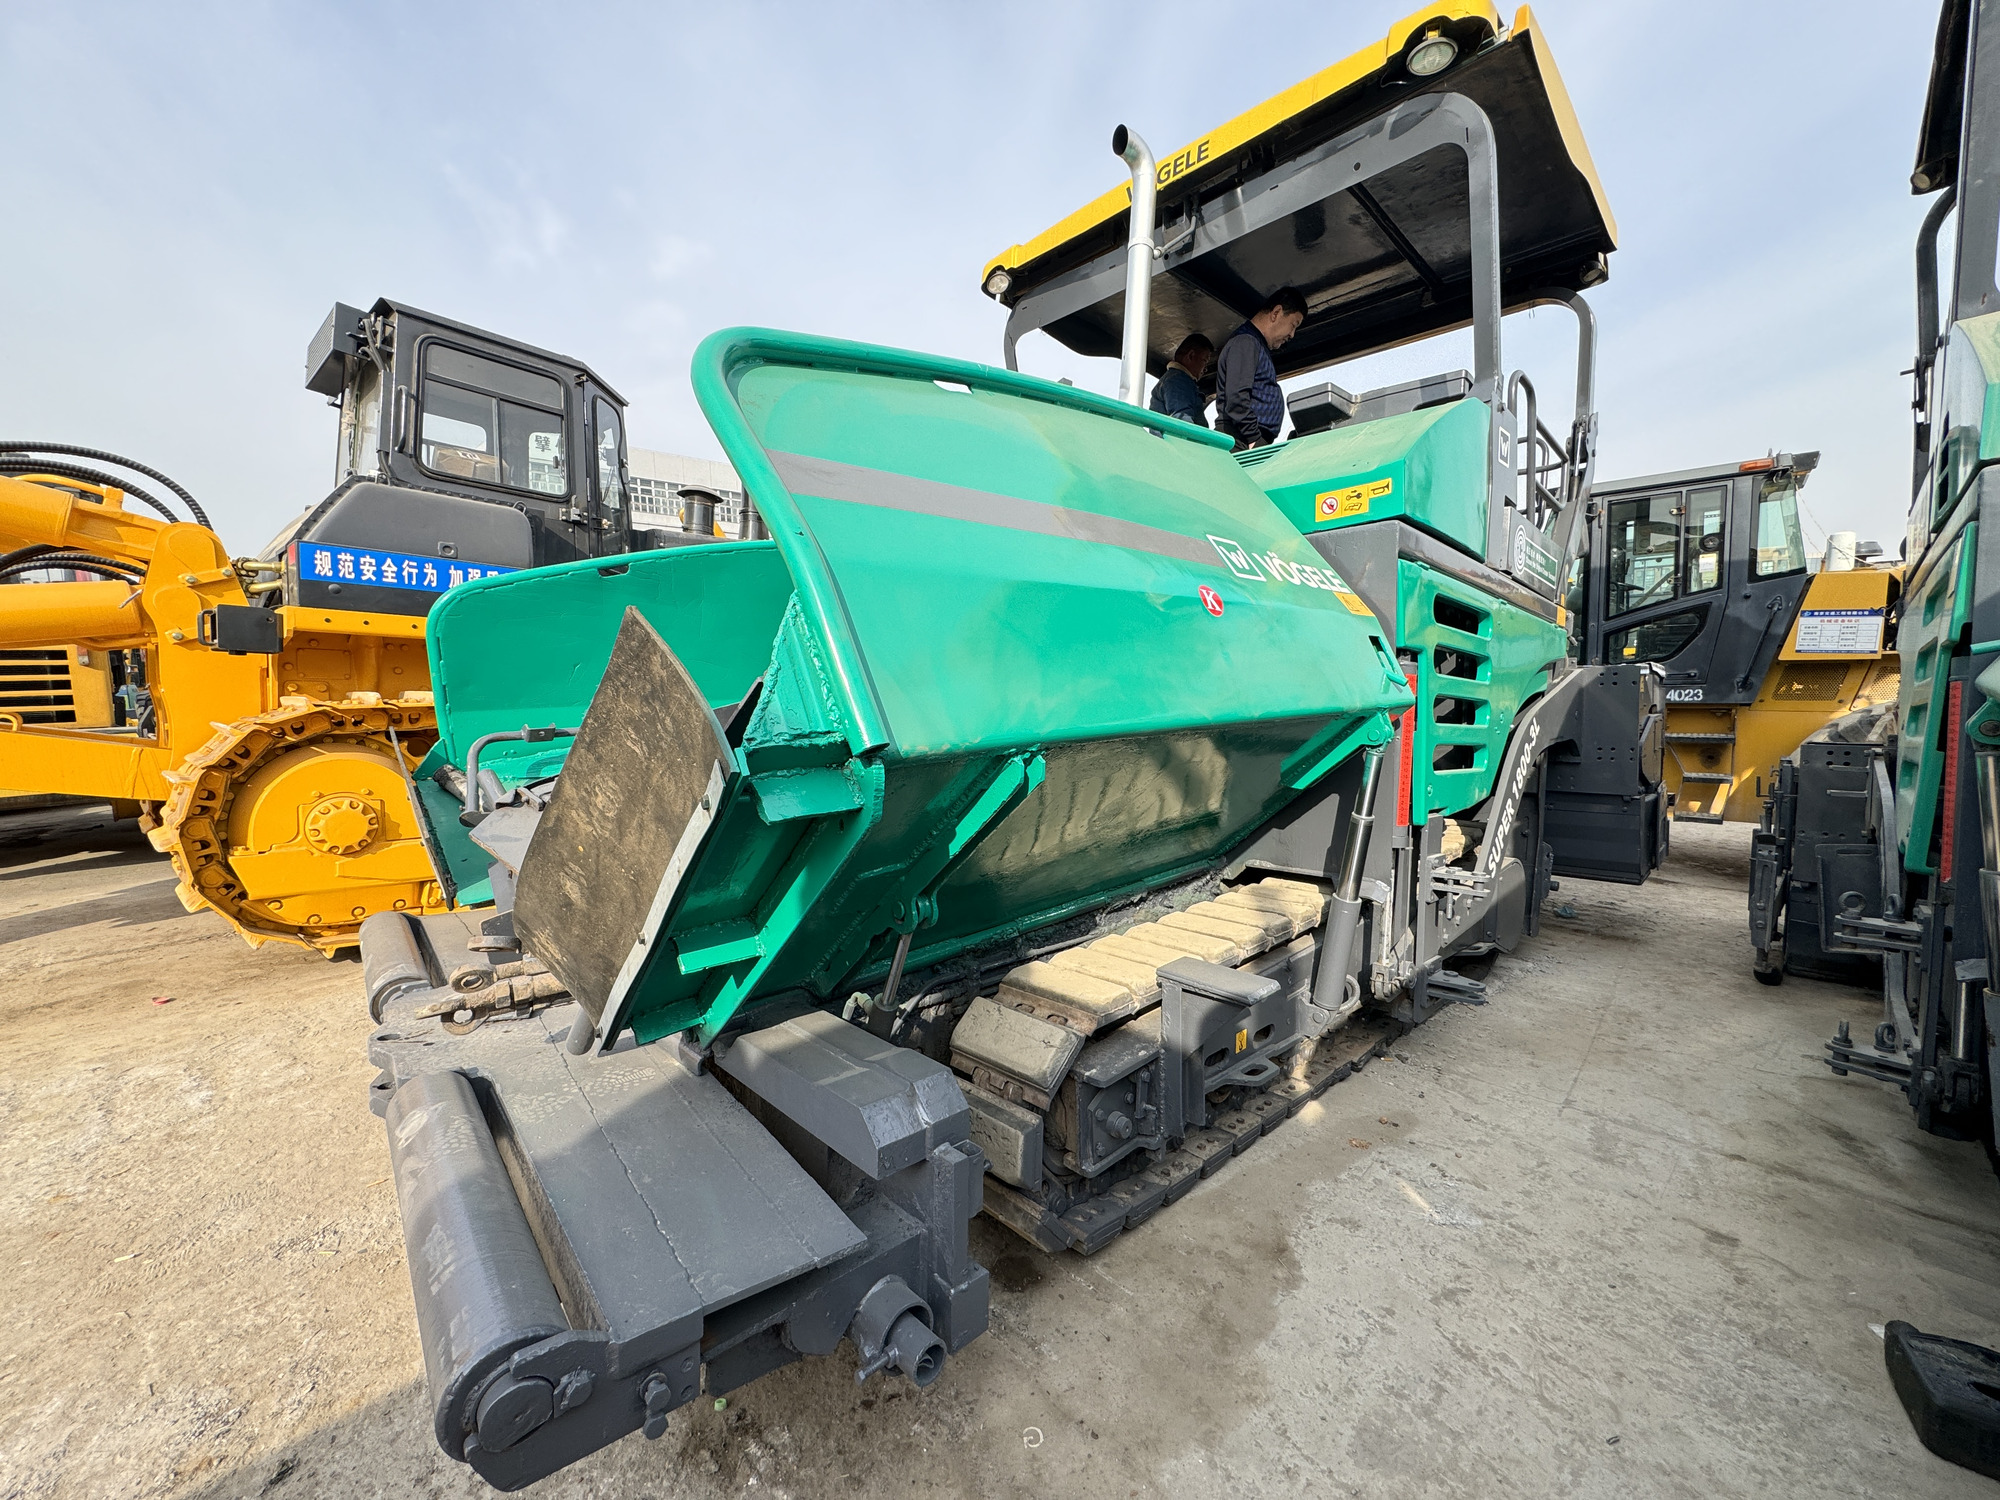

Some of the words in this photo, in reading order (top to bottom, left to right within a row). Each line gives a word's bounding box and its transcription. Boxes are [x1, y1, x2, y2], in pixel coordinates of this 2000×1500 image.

[1126, 139, 1210, 203] GELE
[314, 550, 438, 588] 规范安全行为
[1252, 550, 1351, 594] VÖGELE
[1200, 588, 1222, 612] K
[1665, 688, 1704, 702] 4023
[1488, 798, 1515, 880] SUPER
[1512, 716, 1541, 800] 1800-3L
